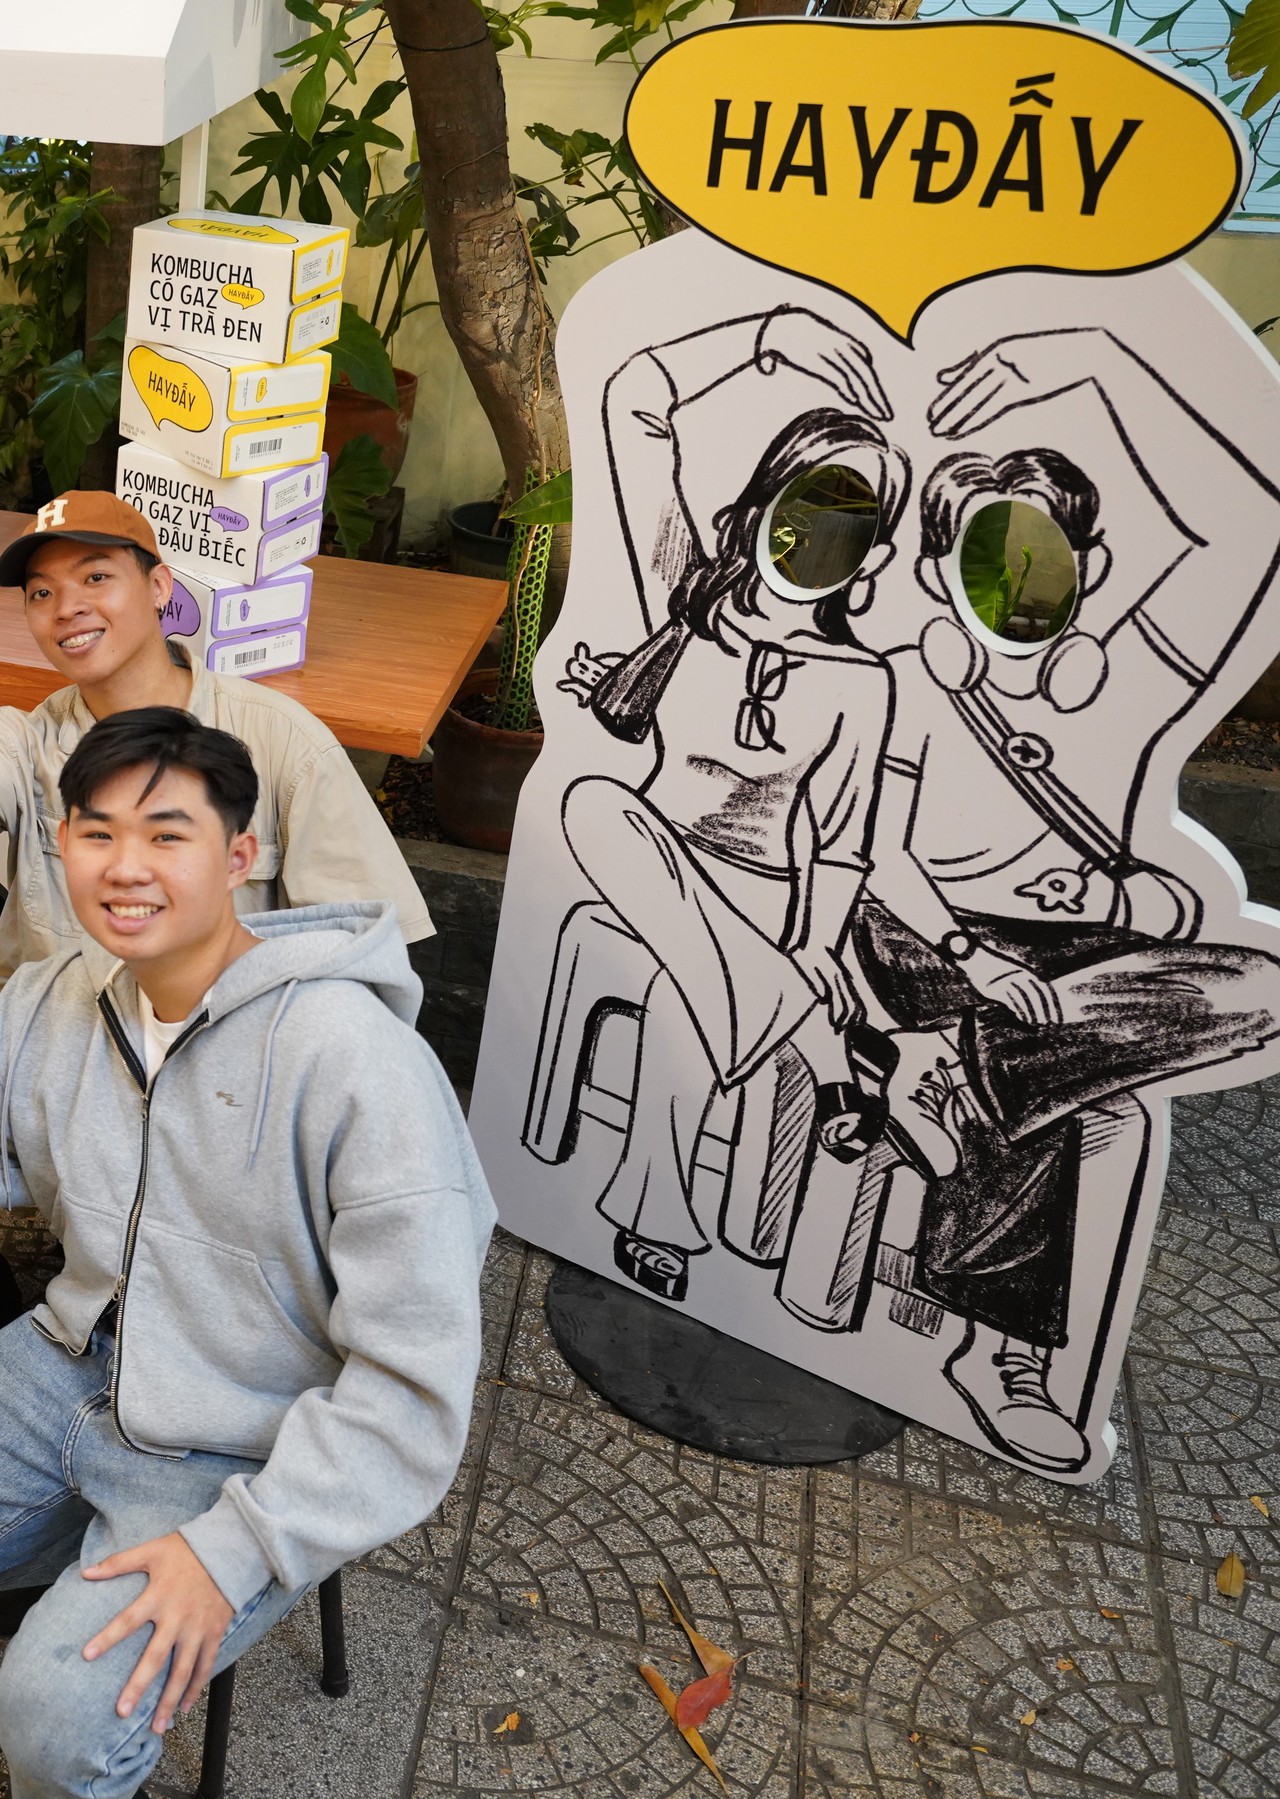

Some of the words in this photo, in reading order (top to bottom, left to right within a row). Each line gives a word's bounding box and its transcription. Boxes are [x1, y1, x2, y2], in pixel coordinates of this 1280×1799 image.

[707, 73, 1144, 217] HAYĐẤY
[151, 253, 254, 288] KOMBUCHA
[150, 278, 174, 301] CÓ
[180, 284, 219, 309] GAZ
[148, 305, 172, 332] VỊ
[178, 310, 216, 335] TRÀ
[222, 318, 262, 343] ĐEN
[148, 371, 196, 413] HAYĐẤY
[123, 469, 214, 509] KOMBUCHA
[35, 499, 68, 533] H
[148, 501, 183, 526] GAZ
[189, 510, 211, 537] VỊ
[158, 526, 193, 552] ĐẬU
[199, 537, 246, 567] BIẾC
